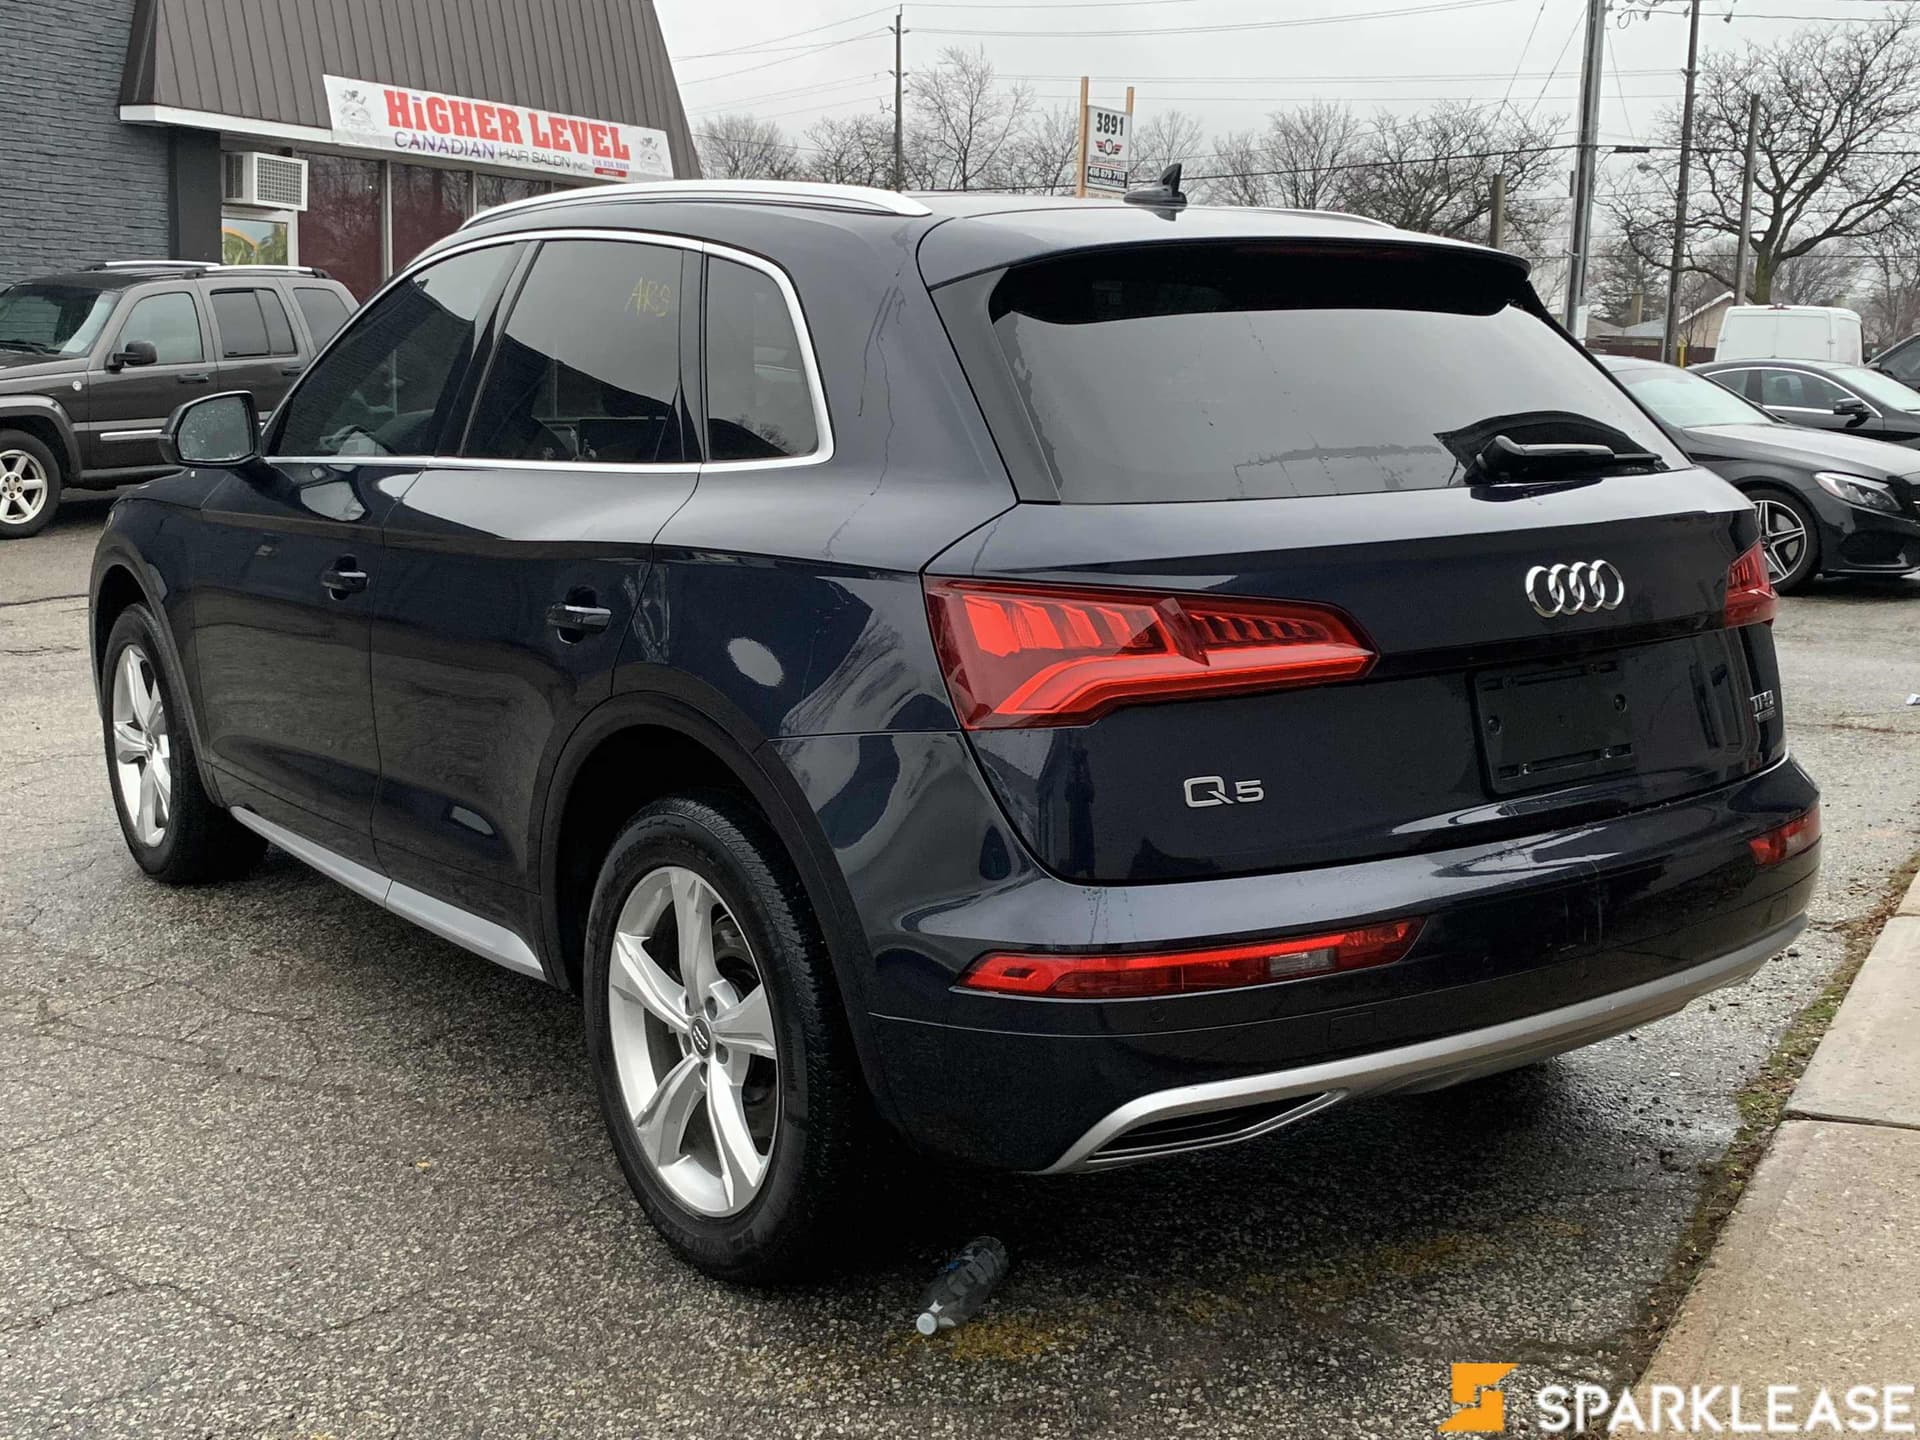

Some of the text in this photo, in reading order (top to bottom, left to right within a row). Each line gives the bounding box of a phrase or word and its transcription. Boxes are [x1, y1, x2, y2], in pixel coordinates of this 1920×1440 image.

[528, 113, 631, 161] LEVEL
[1096, 112, 1124, 136] 3891
[394, 131, 495, 159] CANADIAN
[499, 147, 529, 163] HAIR
[532, 151, 571, 168] SALON
[1184, 776, 1265, 808] Q5
